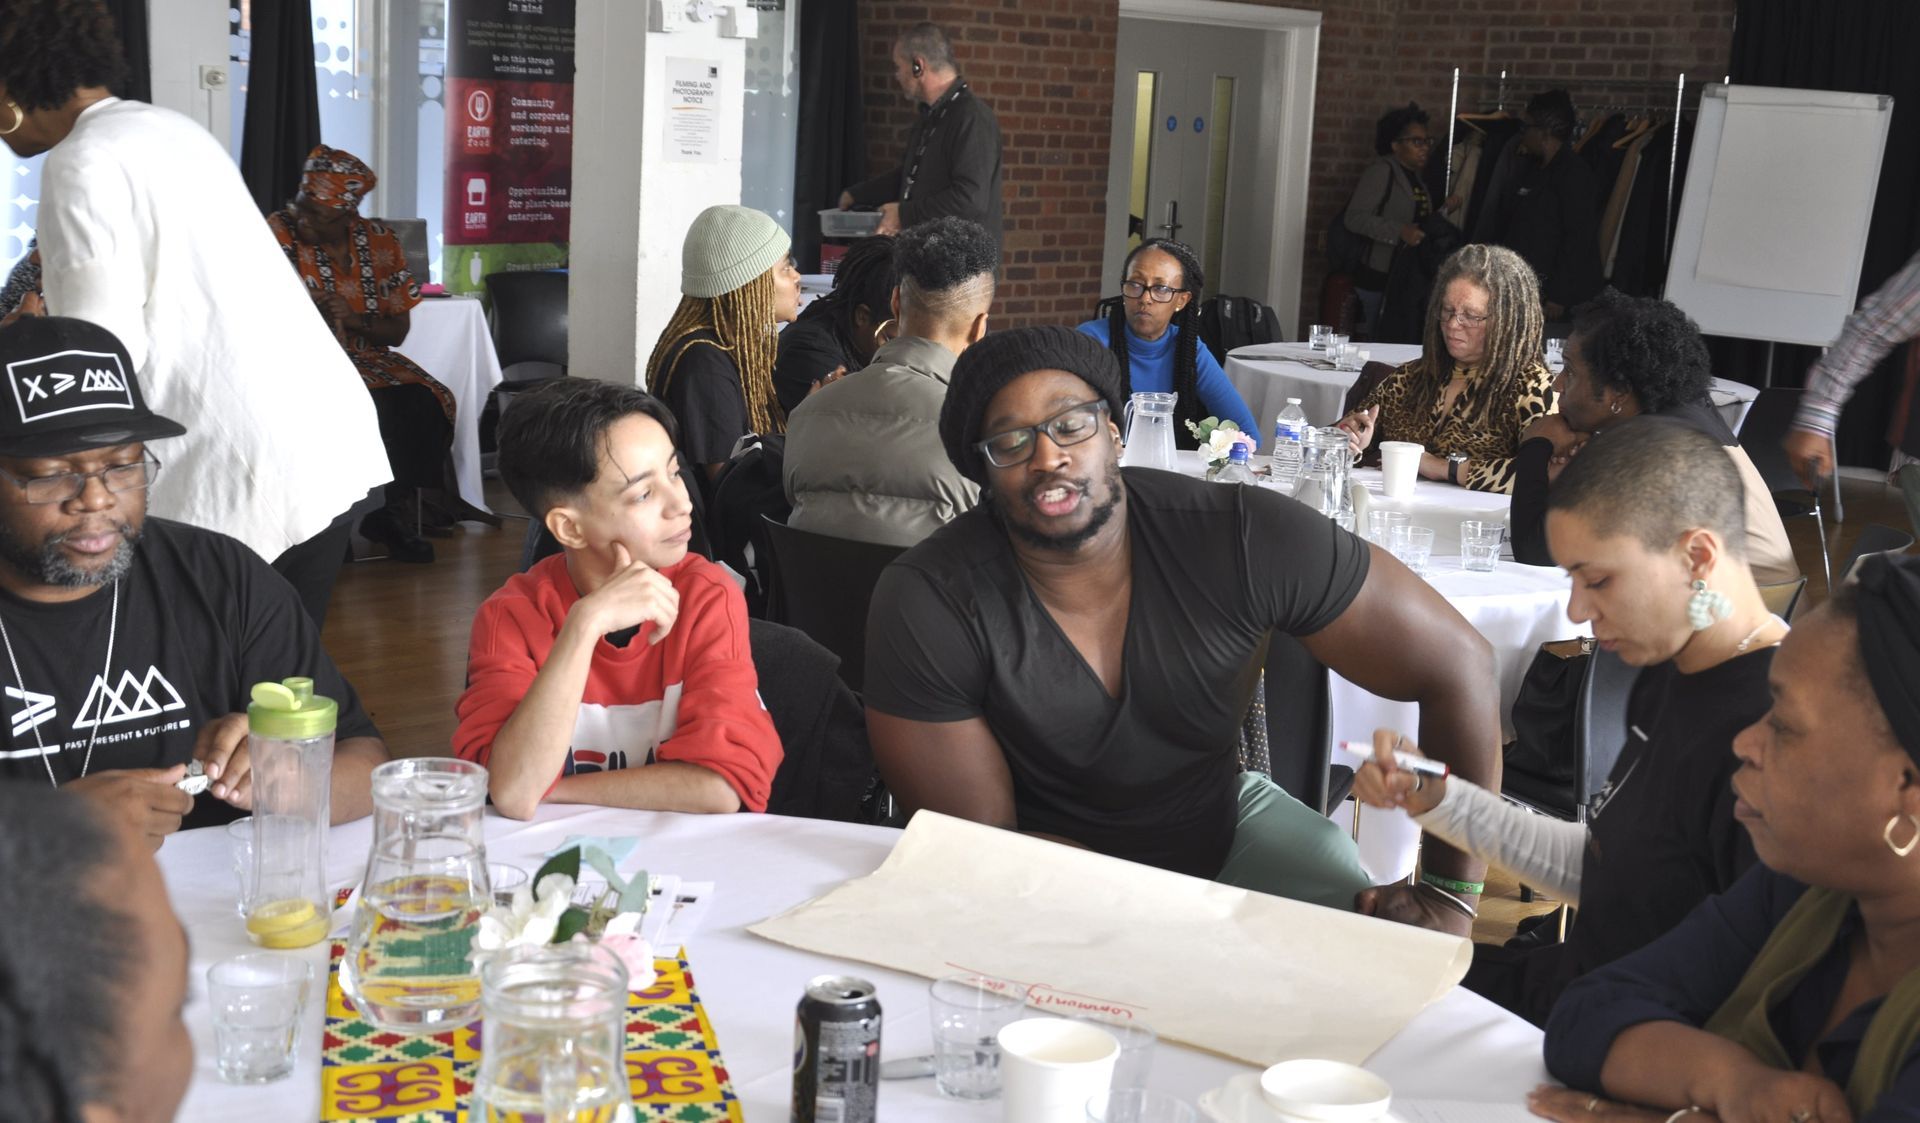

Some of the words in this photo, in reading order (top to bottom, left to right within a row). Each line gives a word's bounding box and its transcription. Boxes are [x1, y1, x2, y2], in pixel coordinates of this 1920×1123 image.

[508, 1, 518, 12] in
[521, 4, 543, 14] mind
[528, 56, 554, 66] through
[675, 80, 698, 88] FILMING
[700, 81, 712, 89] AND
[672, 88, 714, 97] PHOTOGRAPHY
[511, 96, 554, 109] Community
[683, 96, 703, 104] NOTICE
[511, 111, 526, 120] and
[529, 112, 570, 122] corporate
[467, 126, 490, 137] EARTH
[510, 124, 552, 134] workshops
[554, 125, 570, 134] and
[467, 138, 489, 147] food
[508, 187, 567, 197] Opportunities
[508, 199, 523, 209] for
[465, 212, 487, 224] EARTH
[64, 739, 87, 750] PAST
[90, 731, 134, 746] PRESENT
[135, 730, 142, 738] &
[144, 721, 178, 737] FUTURE
